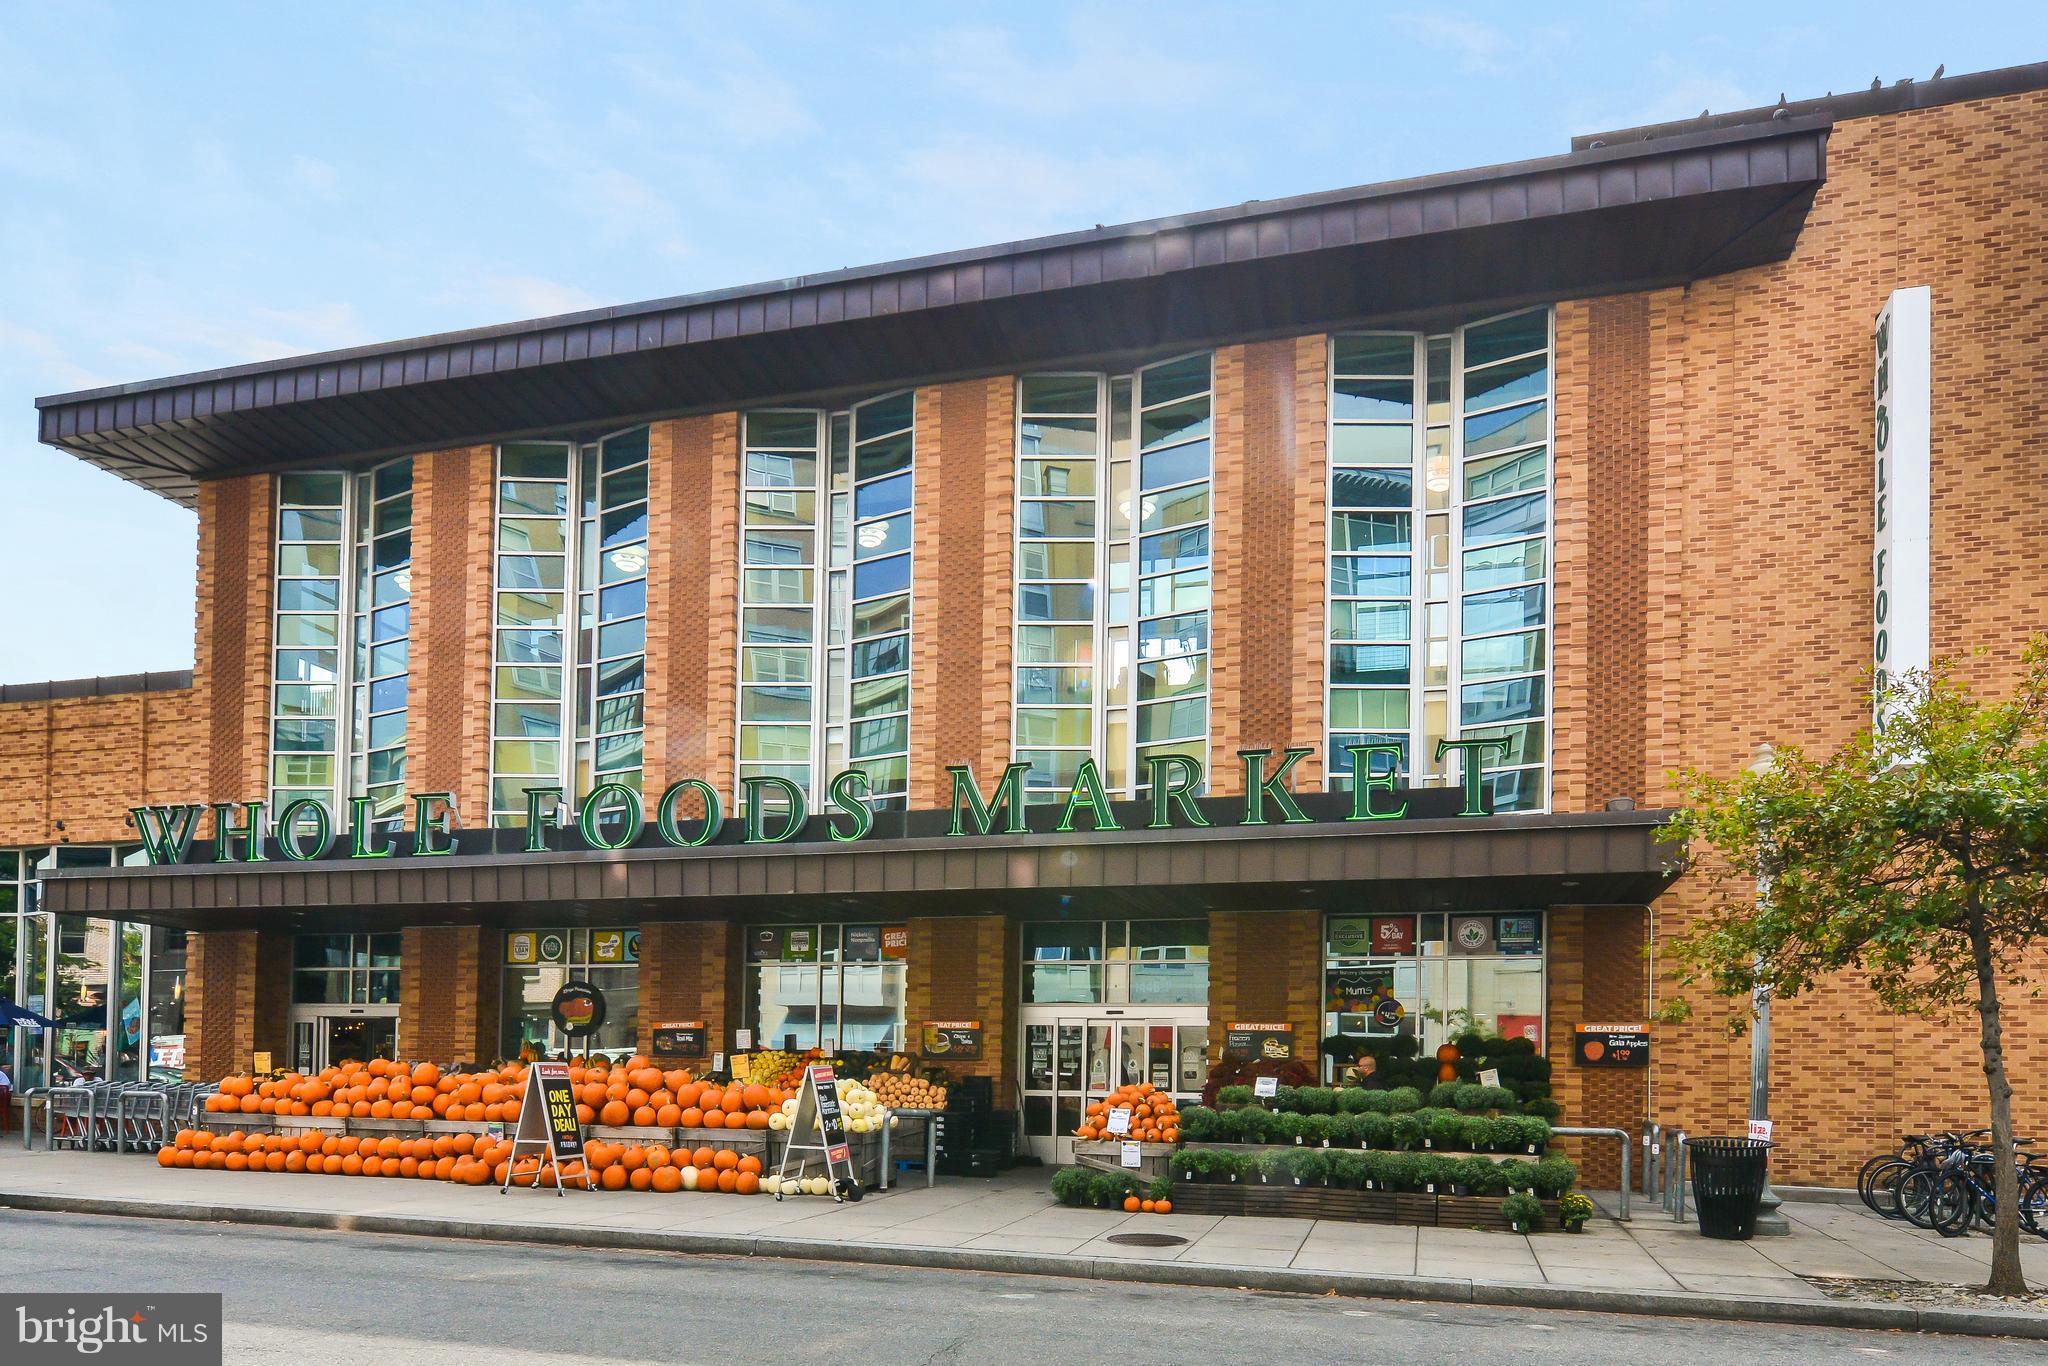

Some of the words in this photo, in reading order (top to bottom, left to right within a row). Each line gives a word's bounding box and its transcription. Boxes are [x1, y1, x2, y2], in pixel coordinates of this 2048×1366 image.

[1876, 313, 1890, 532] WHOLE
[128, 791, 460, 865] WHOLE
[522, 769, 874, 851] FOODS
[945, 736, 1512, 836] MARKET
[885, 932, 908, 941] GREA
[1345, 986, 1373, 995] Mums
[1234, 1023, 1260, 1031] GREAT
[1260, 1023, 1285, 1031] PRICE!
[1613, 1024, 1642, 1032] PRICE!
[1626, 1040, 1648, 1048] Apples
[549, 1089, 570, 1103] ONE
[551, 1103, 572, 1118] DAY
[554, 1118, 577, 1132] DEAL!
